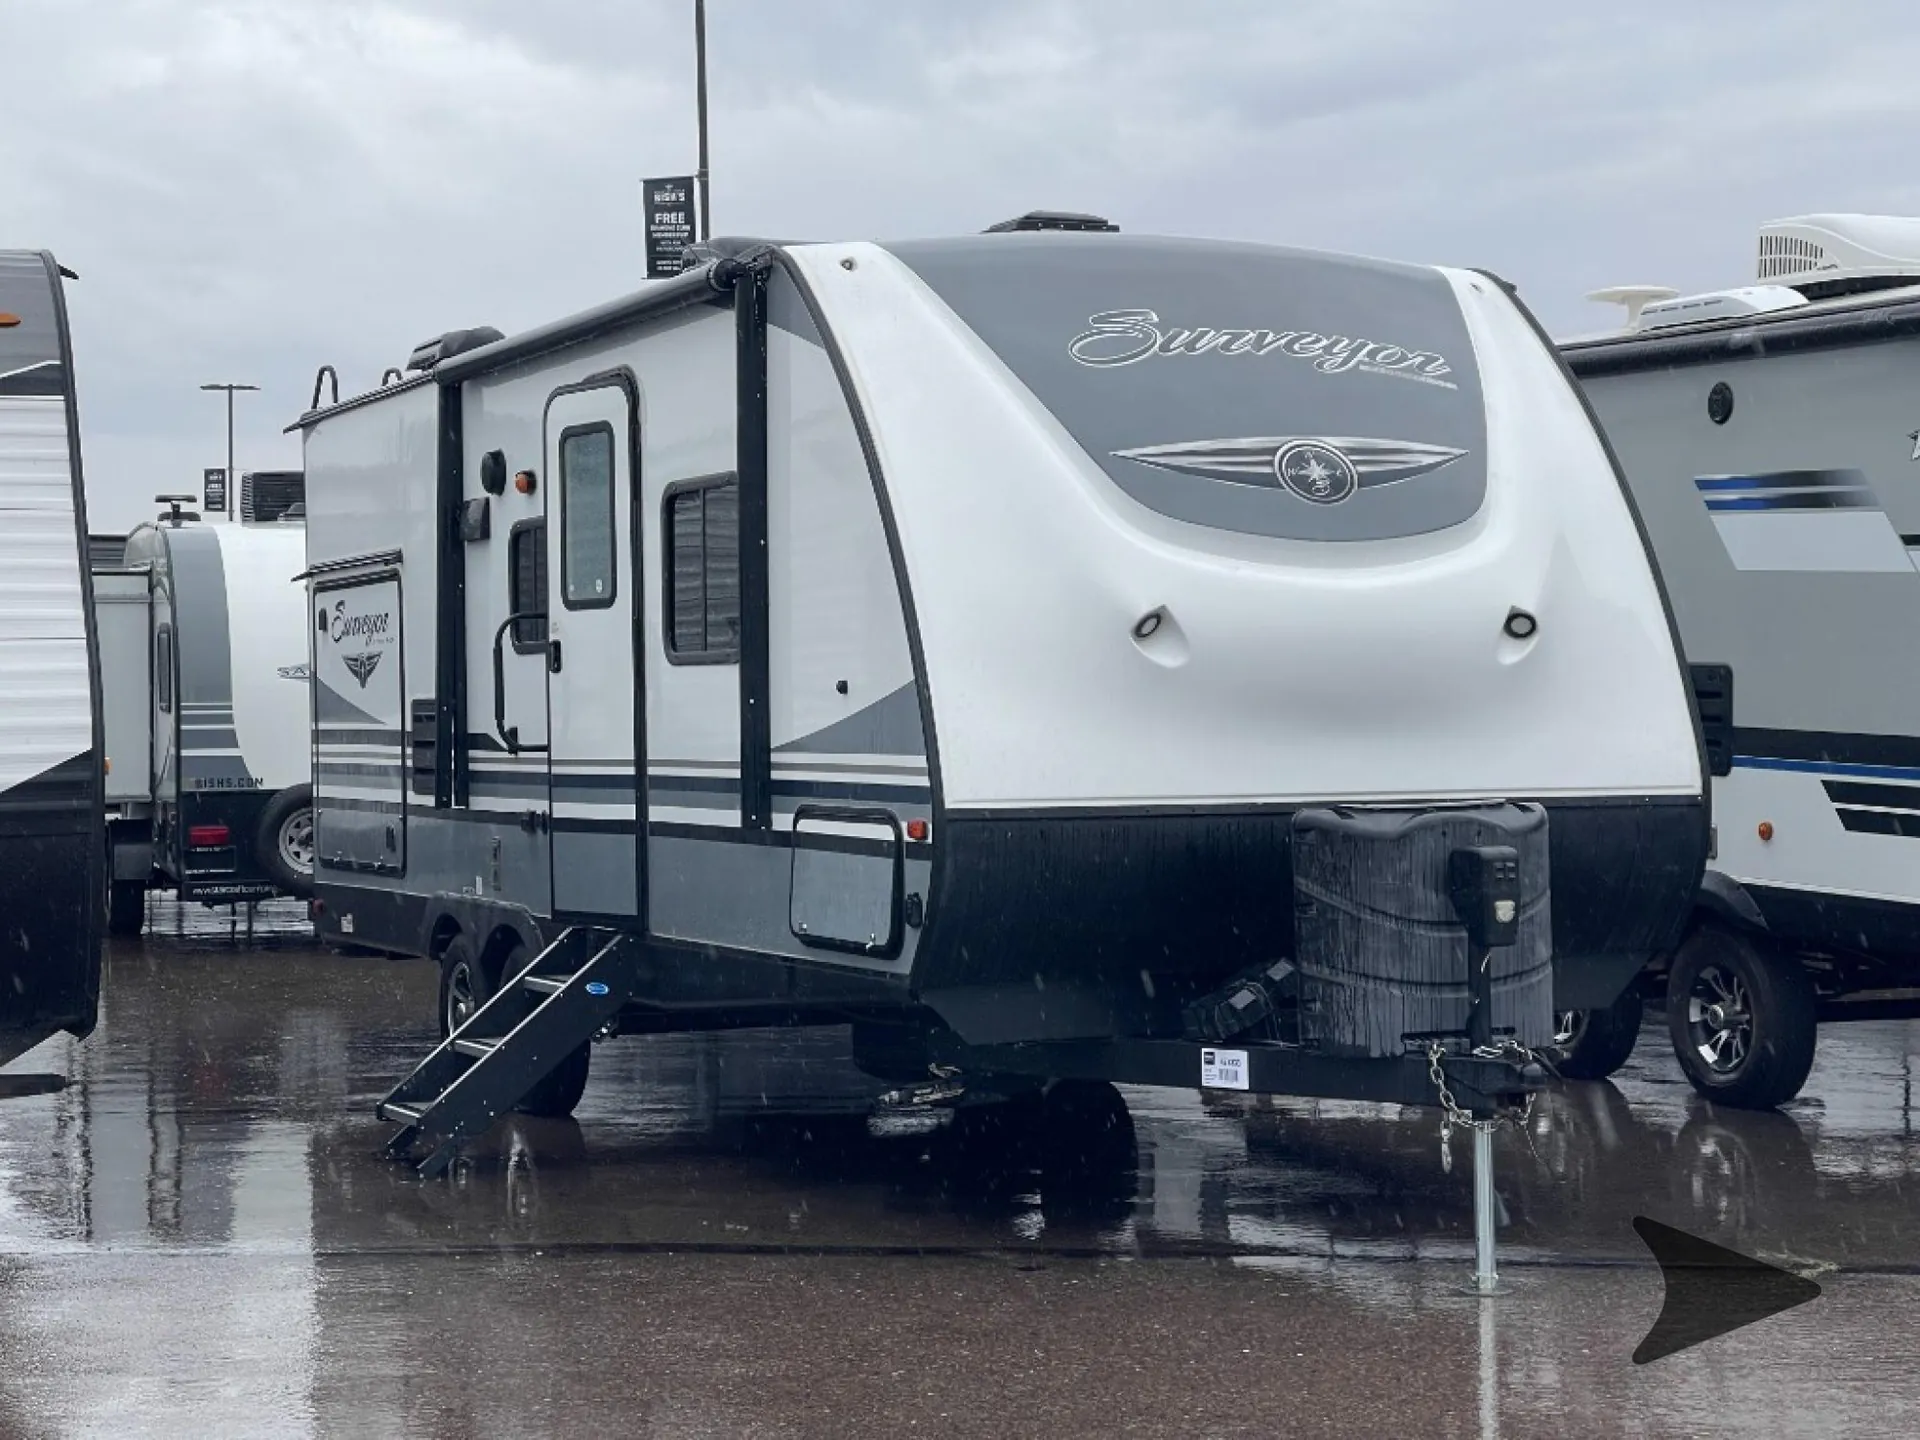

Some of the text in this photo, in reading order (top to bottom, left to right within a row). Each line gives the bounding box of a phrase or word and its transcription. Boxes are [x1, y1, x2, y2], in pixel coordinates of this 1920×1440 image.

[655, 211, 685, 224] FREE
[1068, 308, 1453, 374] Surveyor
[332, 600, 389, 648] Surveyor
[195, 777, 264, 789] BISHS.COM
